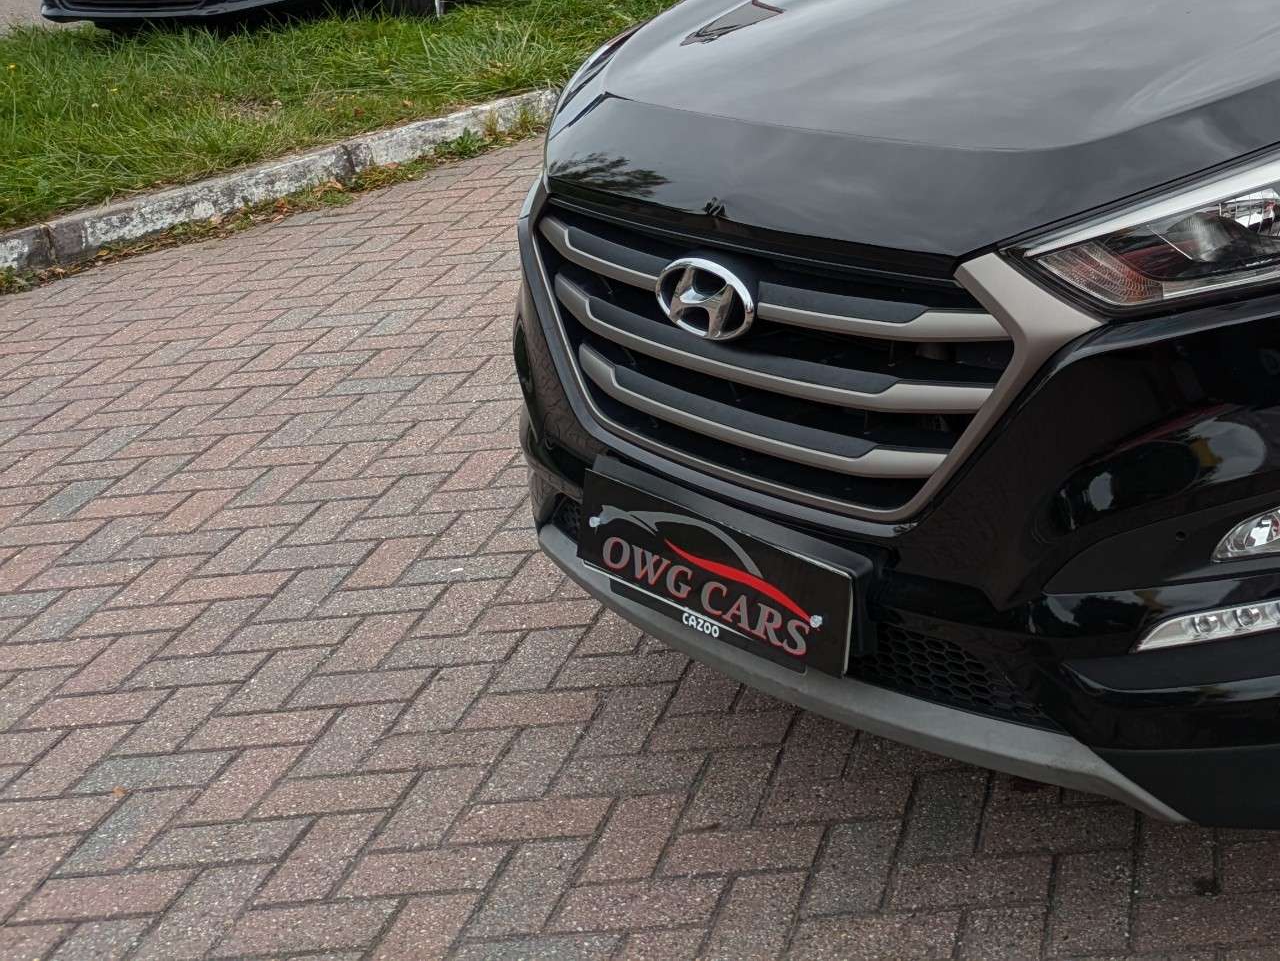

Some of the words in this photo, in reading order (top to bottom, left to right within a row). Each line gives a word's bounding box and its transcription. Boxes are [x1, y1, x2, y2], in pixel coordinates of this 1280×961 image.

[602, 535, 693, 599] OWG
[699, 571, 812, 657] CARS
[681, 611, 720, 639] CAZOO
